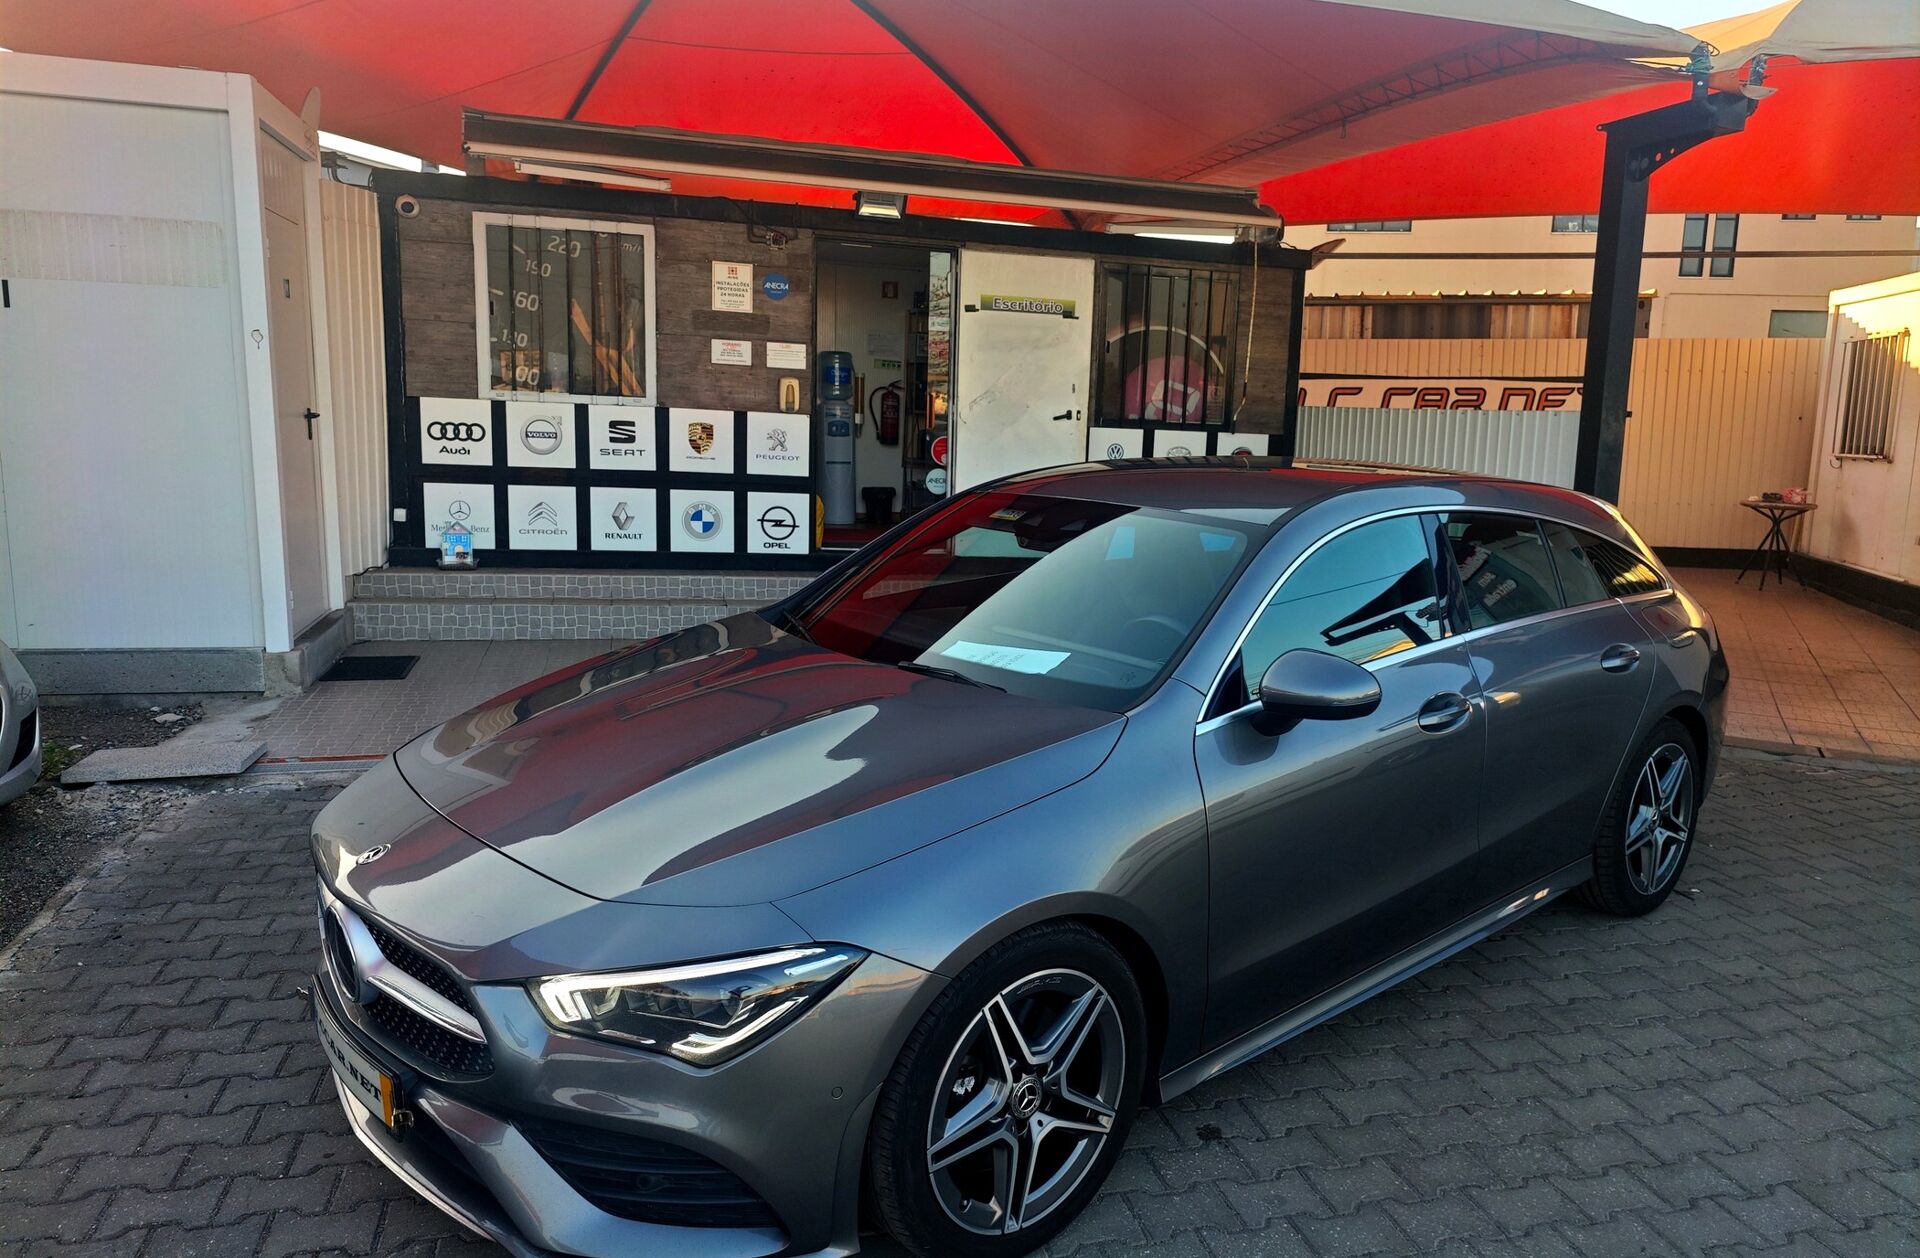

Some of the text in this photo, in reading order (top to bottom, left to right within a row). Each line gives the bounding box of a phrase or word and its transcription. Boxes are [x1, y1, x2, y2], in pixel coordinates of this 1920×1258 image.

[764, 282, 789, 290] ANECRA
[513, 289, 540, 312] 60
[993, 297, 1064, 313] Escritório
[501, 329, 528, 347] 10
[515, 366, 540, 385] 00
[1498, 387, 1583, 410] NE
[439, 445, 471, 456] Audi
[600, 448, 646, 457] SEAT
[519, 527, 568, 536] CITROËN
[604, 532, 643, 540] RENAULT
